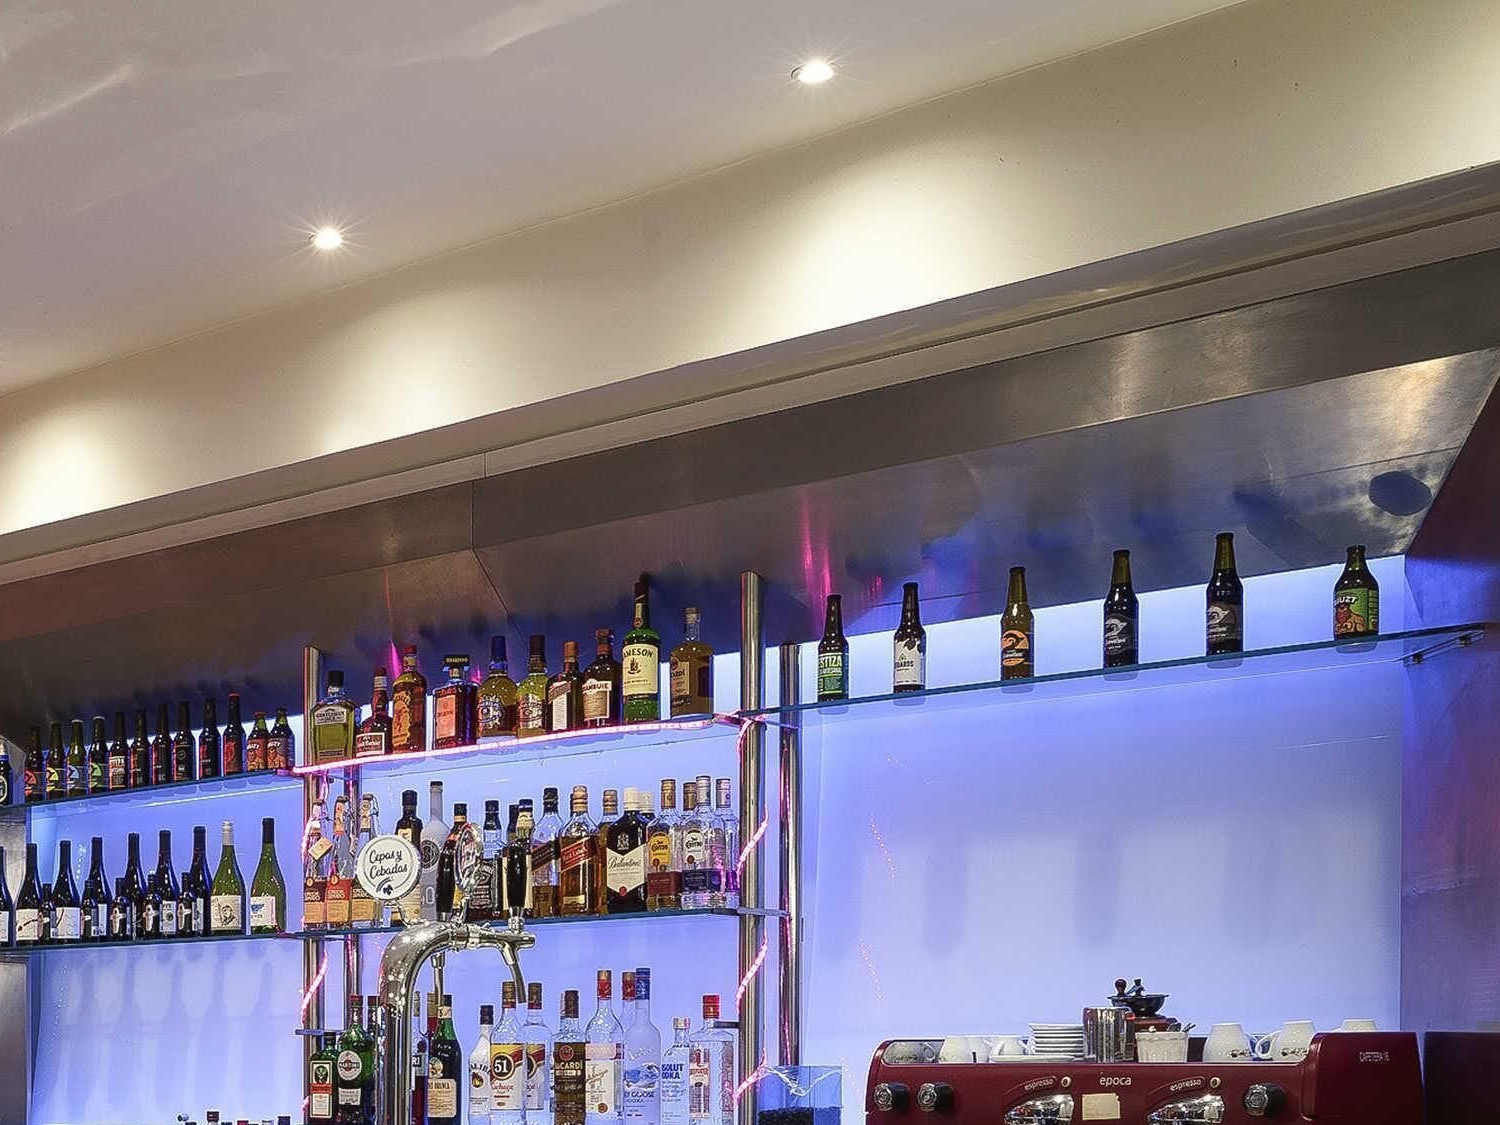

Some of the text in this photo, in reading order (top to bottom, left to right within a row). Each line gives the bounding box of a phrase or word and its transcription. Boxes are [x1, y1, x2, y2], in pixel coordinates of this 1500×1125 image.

[624, 648, 654, 658] AMESON
[819, 656, 843, 668] STIZA
[369, 849, 402, 864] Cepas y
[370, 864, 408, 879] Cebadas
[494, 1060, 508, 1073] 51
[1024, 1078, 1053, 1091] espresso
[1170, 1078, 1201, 1092] espresso
